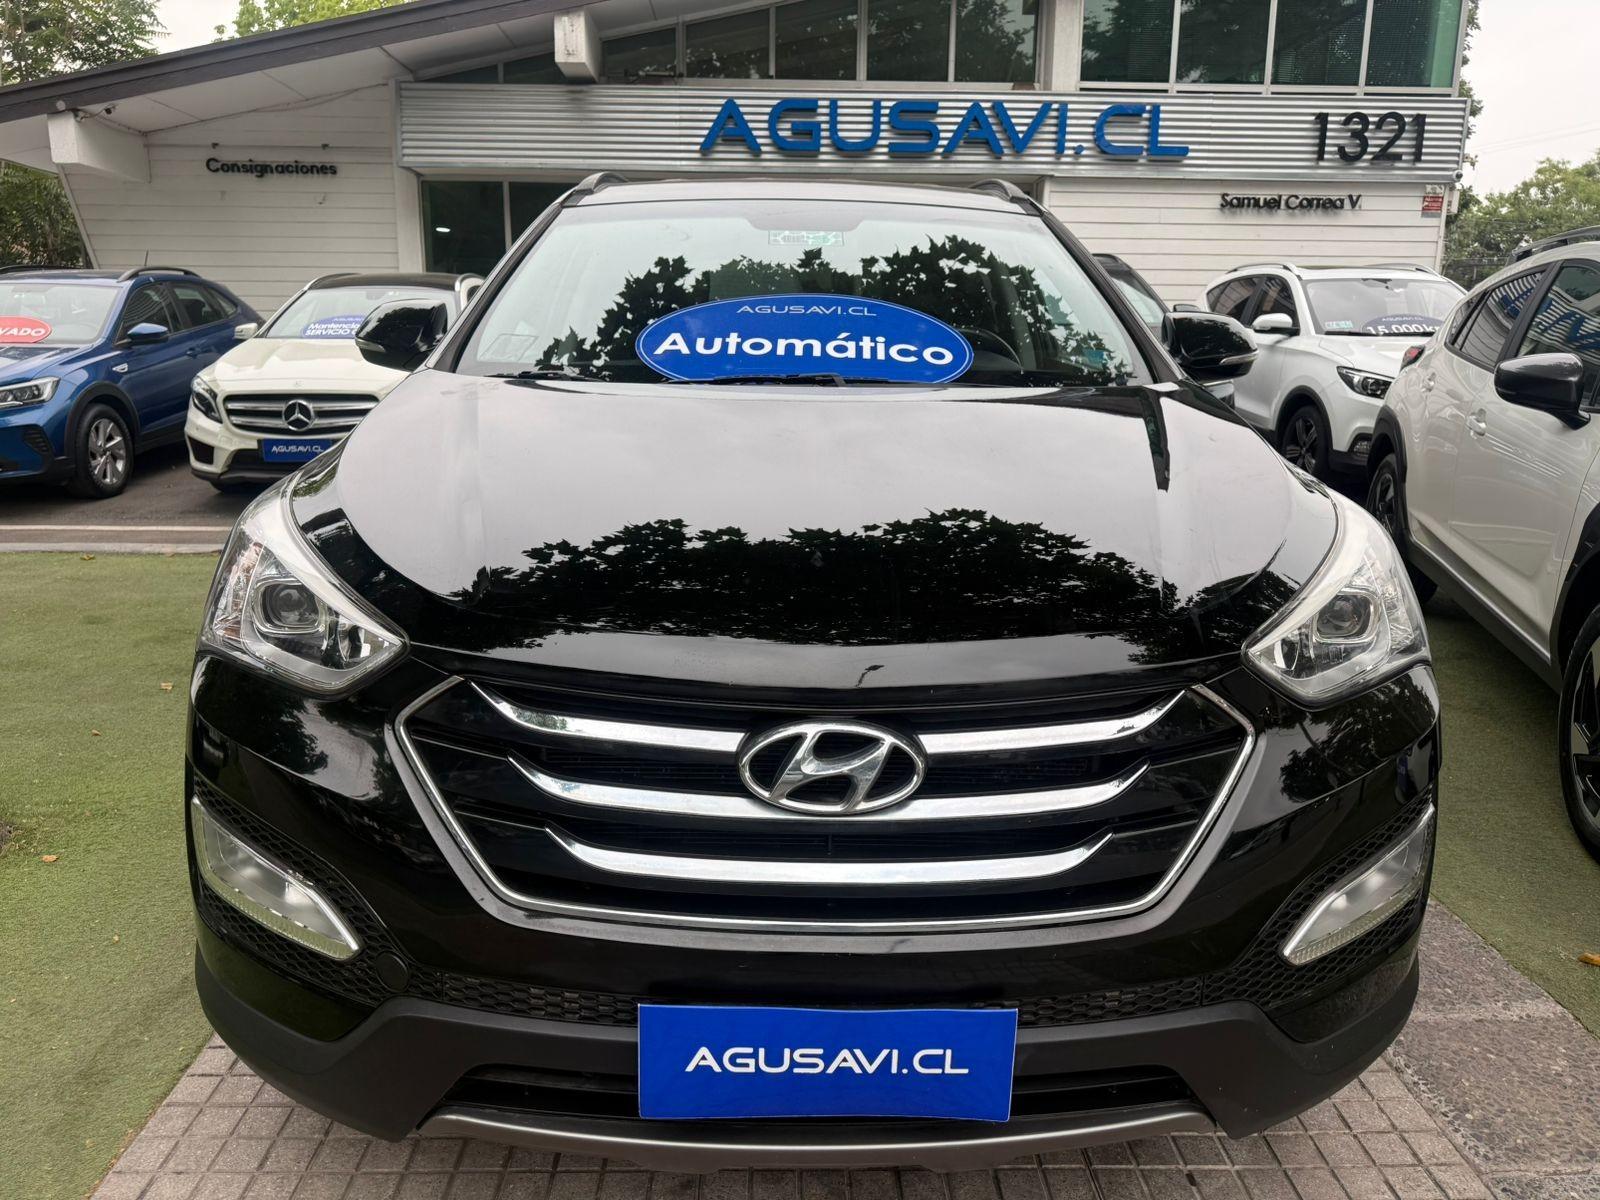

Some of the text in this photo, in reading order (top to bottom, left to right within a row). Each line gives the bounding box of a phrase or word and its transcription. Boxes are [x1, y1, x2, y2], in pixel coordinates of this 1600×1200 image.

[699, 98, 1190, 159] AGUSAVI.CL
[1314, 111, 1427, 162] 1321
[206, 157, 337, 178] Consignaciones
[1220, 193, 1282, 209] Samuel
[1285, 194, 1345, 210] Correa
[736, 304, 877, 317] AGUSAVI.CL
[653, 332, 954, 366] Automático
[685, 1046, 969, 1075] AGUSAVI.CL
